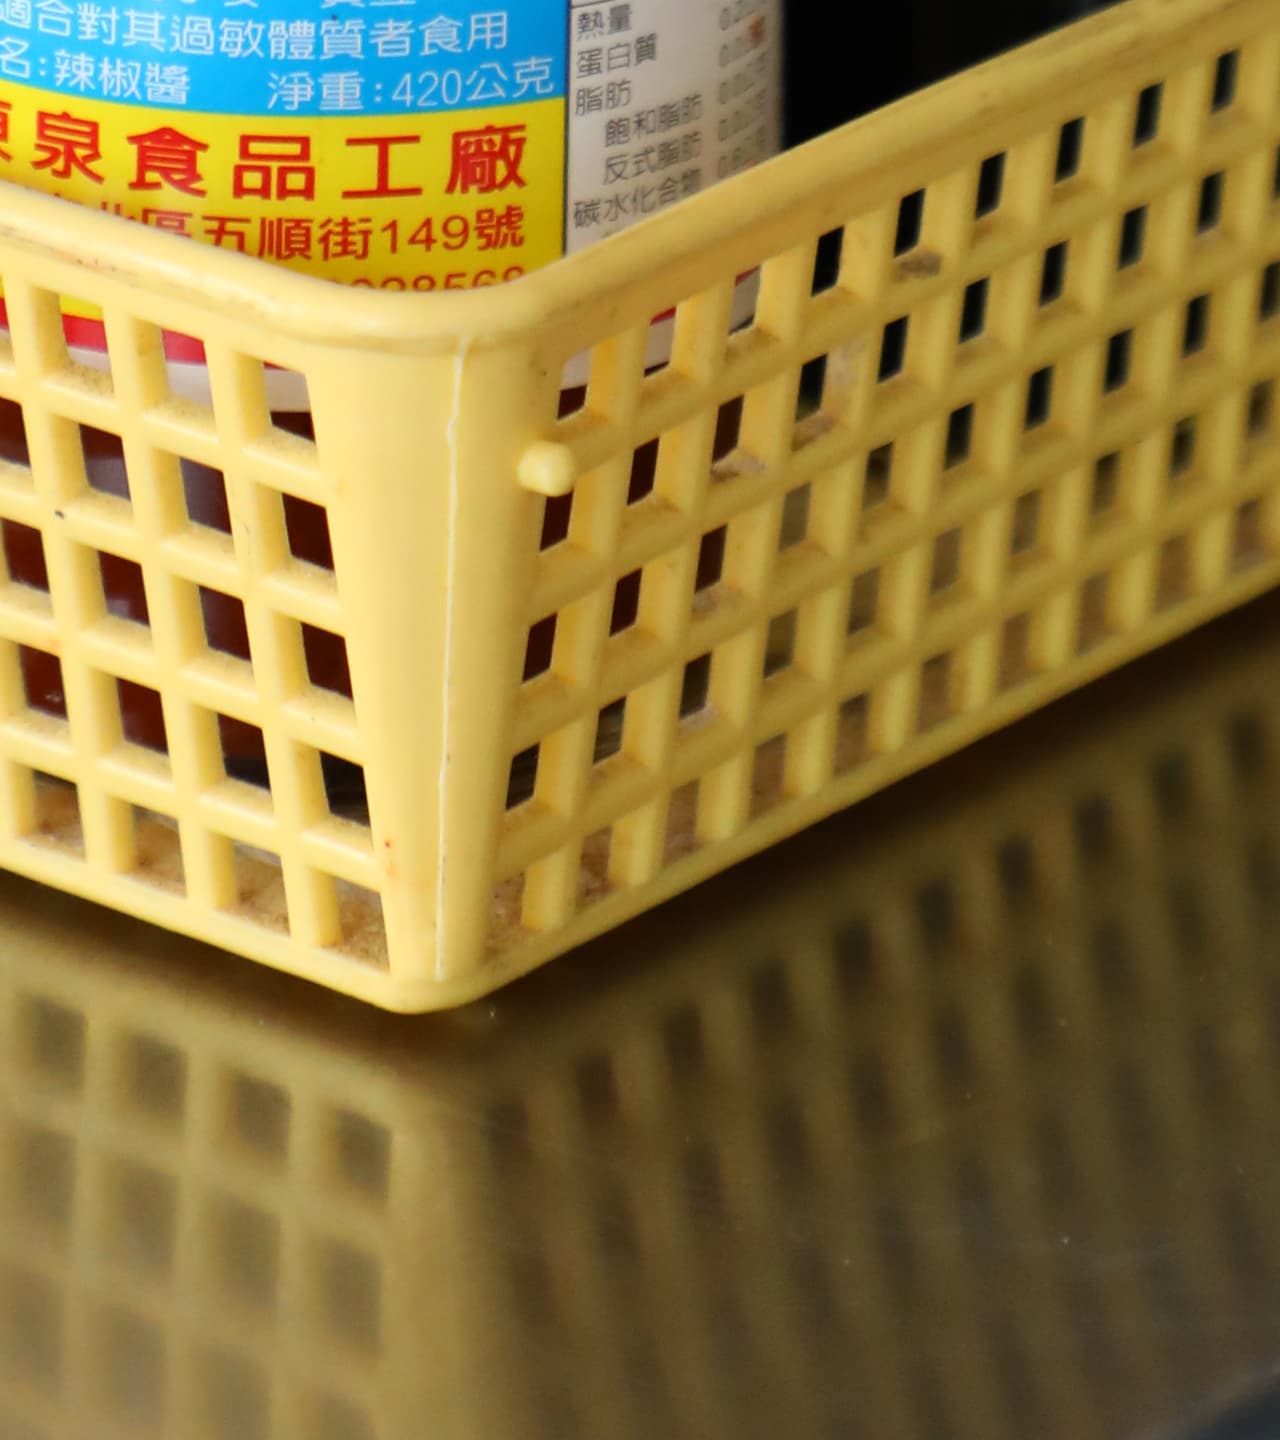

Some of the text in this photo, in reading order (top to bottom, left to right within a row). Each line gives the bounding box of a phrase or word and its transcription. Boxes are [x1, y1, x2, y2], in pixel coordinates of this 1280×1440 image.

[577, 3, 632, 41] 熱量
[576, 32, 657, 80] 蛋白質
[575, 79, 632, 117] 脂肪
[604, 92, 703, 148] 飽和脂肪
[602, 130, 703, 186] 反式脂肪
